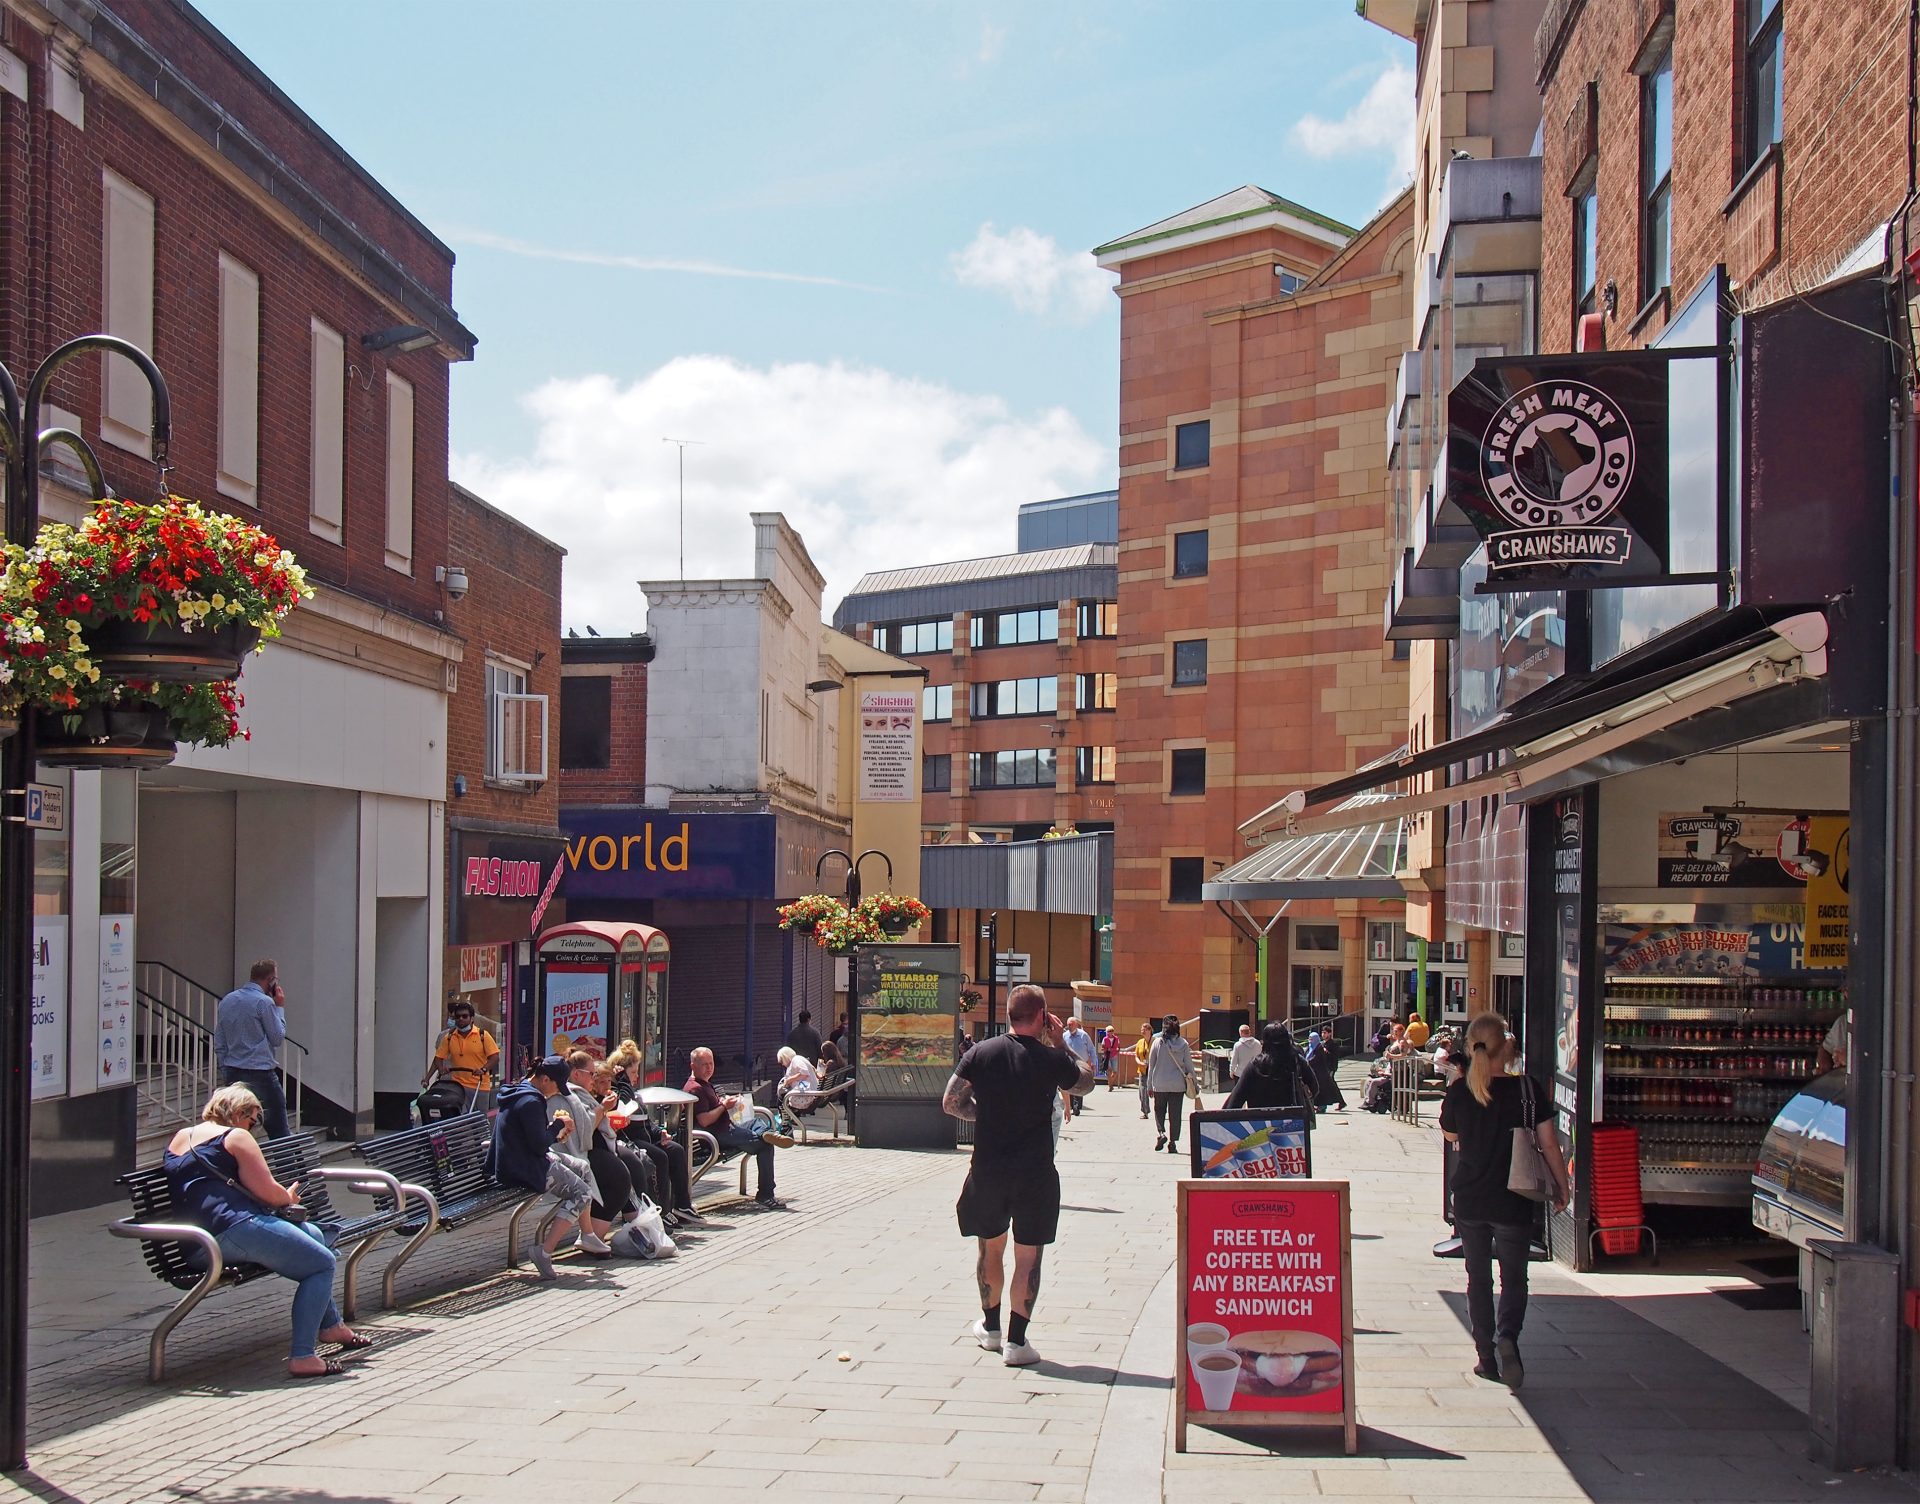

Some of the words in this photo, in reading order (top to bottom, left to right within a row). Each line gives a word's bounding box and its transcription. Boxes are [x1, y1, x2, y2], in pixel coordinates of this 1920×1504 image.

[1489, 393, 1543, 462] FRESH
[1551, 389, 1616, 430] MEAT
[1498, 485, 1563, 525] FOOD
[1571, 495, 1603, 520] TO
[1603, 452, 1625, 489] GO
[1498, 534, 1616, 559] CRAWSHAWS
[46, 815, 57, 825] only
[1671, 864, 1686, 872] THE
[1687, 864, 1705, 872] DELI
[465, 857, 541, 897] FASHION
[1671, 874, 1699, 882] READY
[1700, 874, 1712, 882] TO
[1713, 874, 1731, 882] EAT
[1818, 905, 1838, 919] FACE
[1705, 929, 1749, 944] SLUSH
[1819, 924, 1844, 938] MUST
[560, 940, 596, 948] Telephone
[1810, 944, 1819, 957] IN
[1820, 944, 1846, 957] THESE
[462, 948, 480, 982] SALE
[485, 947, 496, 979] £5
[555, 954, 573, 962] Coins
[574, 954, 581, 962] &
[580, 954, 599, 962] Cards
[880, 973, 893, 982] 25
[894, 974, 925, 982] YEARS
[926, 974, 939, 982] OF
[554, 983, 600, 1002] PICNIC
[881, 981, 914, 989] WATCHING
[914, 982, 939, 990] CHEESE
[903, 989, 939, 997] SLOWLY
[553, 998, 601, 1017] PERFECT
[881, 996, 904, 1009] INTO
[906, 997, 938, 1009] STEAK
[552, 1010, 600, 1034] PIZZA
[1243, 1156, 1276, 1176] SLU
[1238, 1202, 1289, 1214] CRAWSHAWS
[1213, 1229, 1257, 1246] FREE
[1260, 1229, 1293, 1246] TEA
[1297, 1232, 1316, 1247] or
[1205, 1252, 1274, 1269] COFFEE
[1276, 1252, 1322, 1269] WITH
[1192, 1275, 1229, 1293] ANY
[1232, 1275, 1336, 1293] BREAKFAST
[1215, 1298, 1313, 1316] SANDWICH
